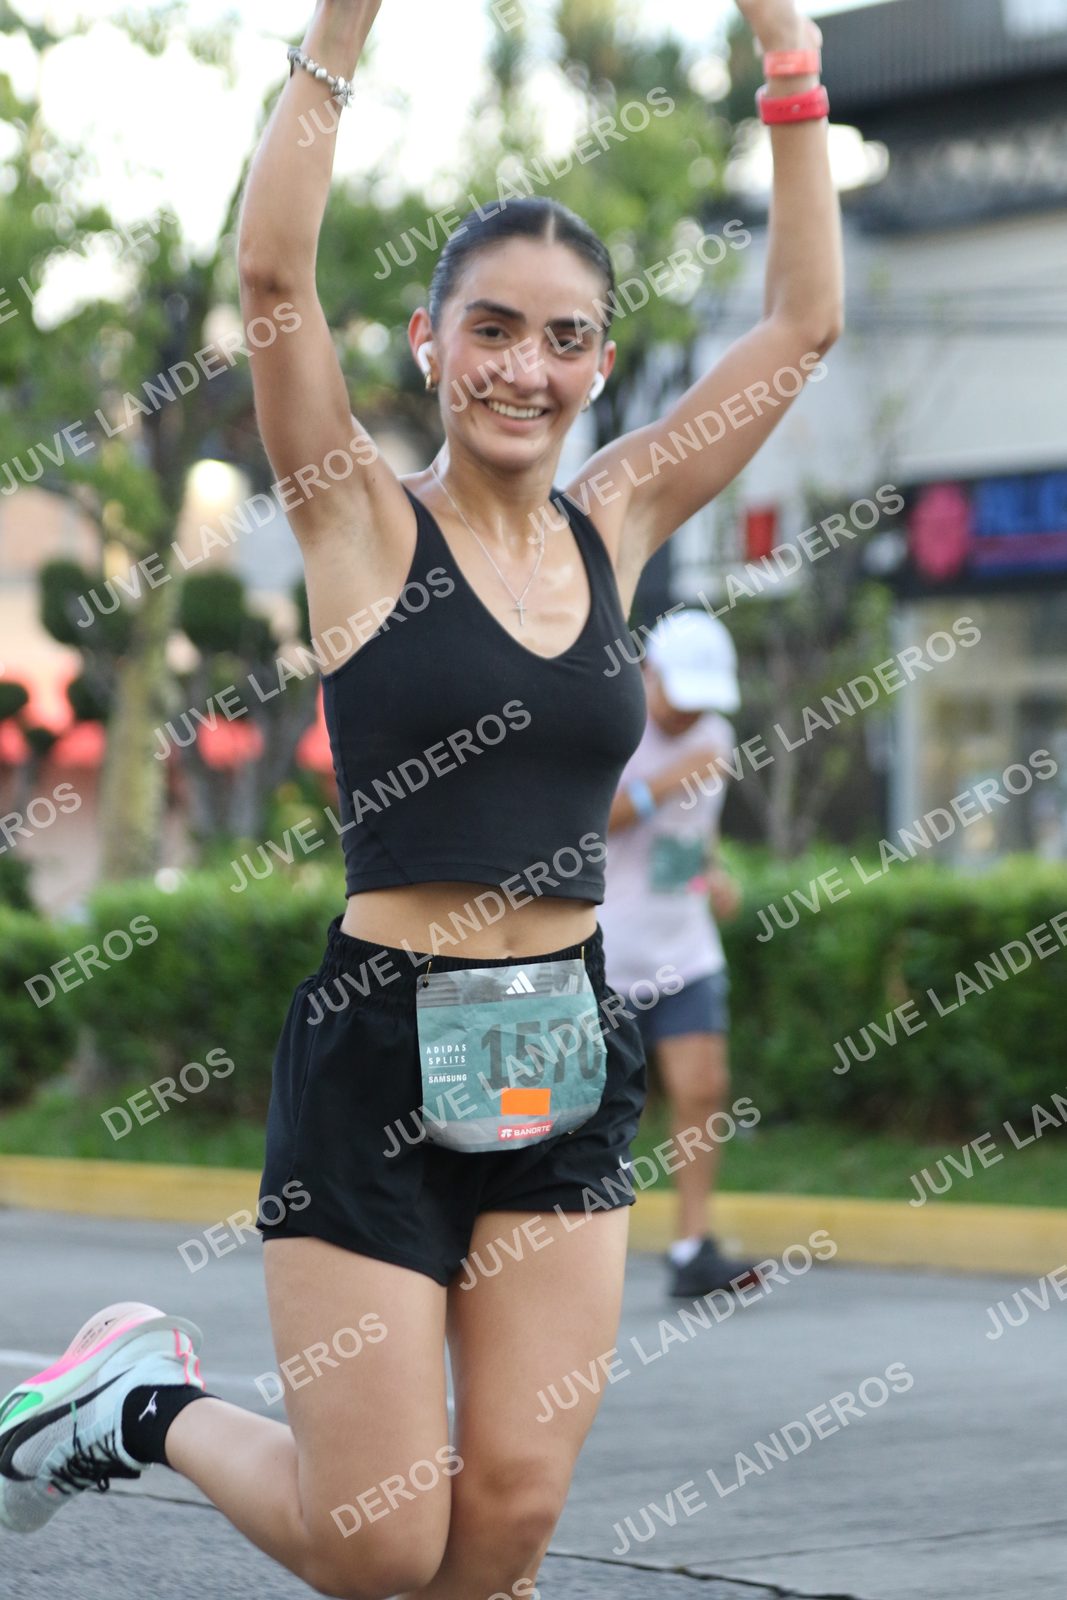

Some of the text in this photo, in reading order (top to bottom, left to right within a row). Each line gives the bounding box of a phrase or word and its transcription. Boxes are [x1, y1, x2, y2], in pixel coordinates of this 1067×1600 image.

[426, 1043, 467, 1055] ADIDAS
[428, 1055, 466, 1065] SPLITS
[428, 1073, 467, 1084] SAMSUNG
[513, 1124, 551, 1136] BANORTE
